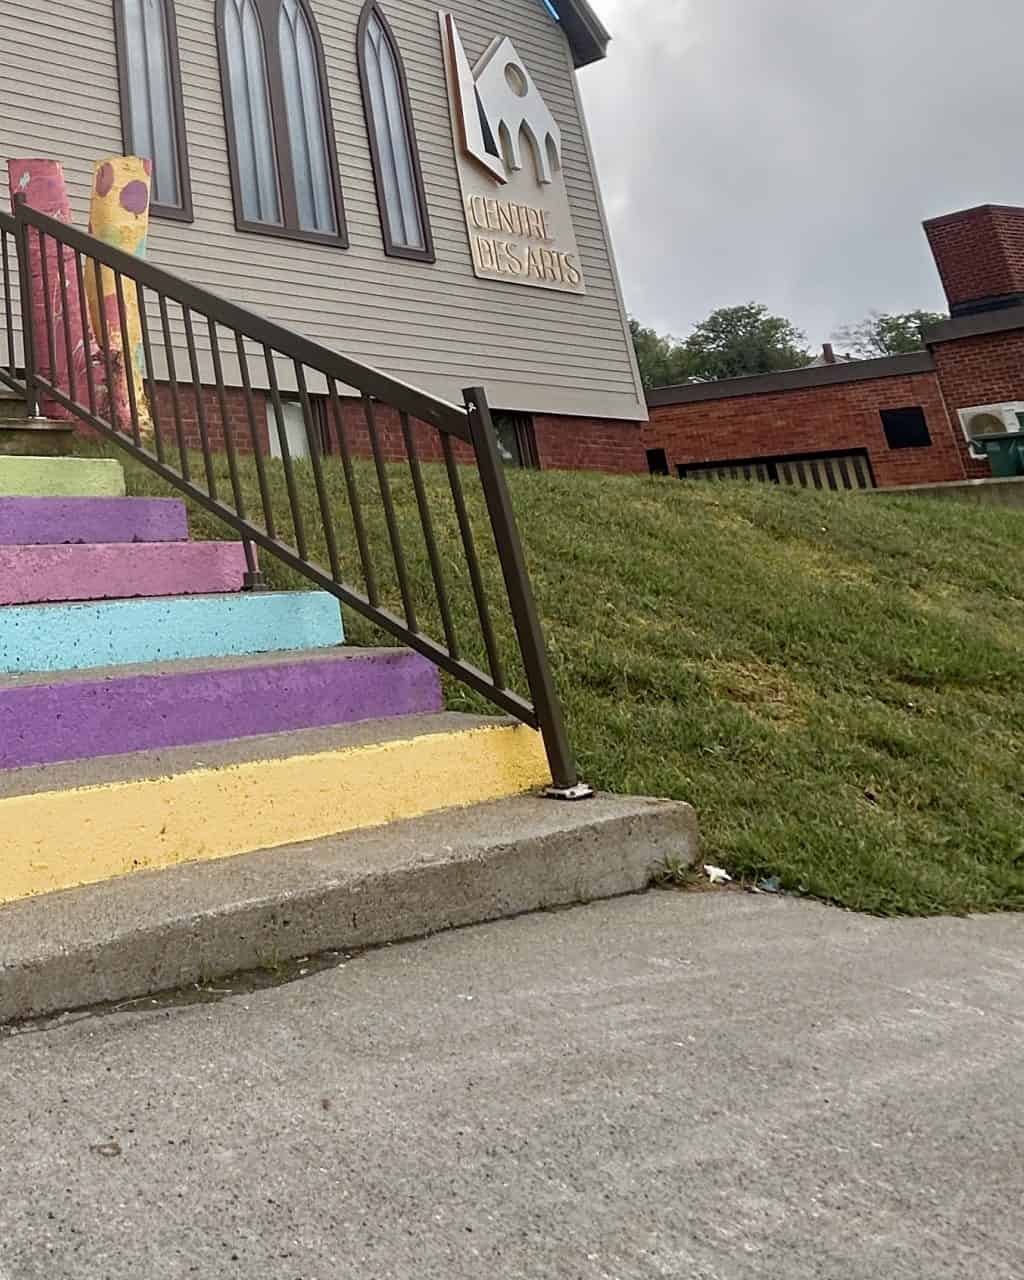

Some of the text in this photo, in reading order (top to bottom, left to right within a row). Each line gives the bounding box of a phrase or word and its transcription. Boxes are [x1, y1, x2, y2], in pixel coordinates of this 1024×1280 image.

[468, 194, 552, 242] CENTRE
[476, 235, 581, 286] DES ARTS
